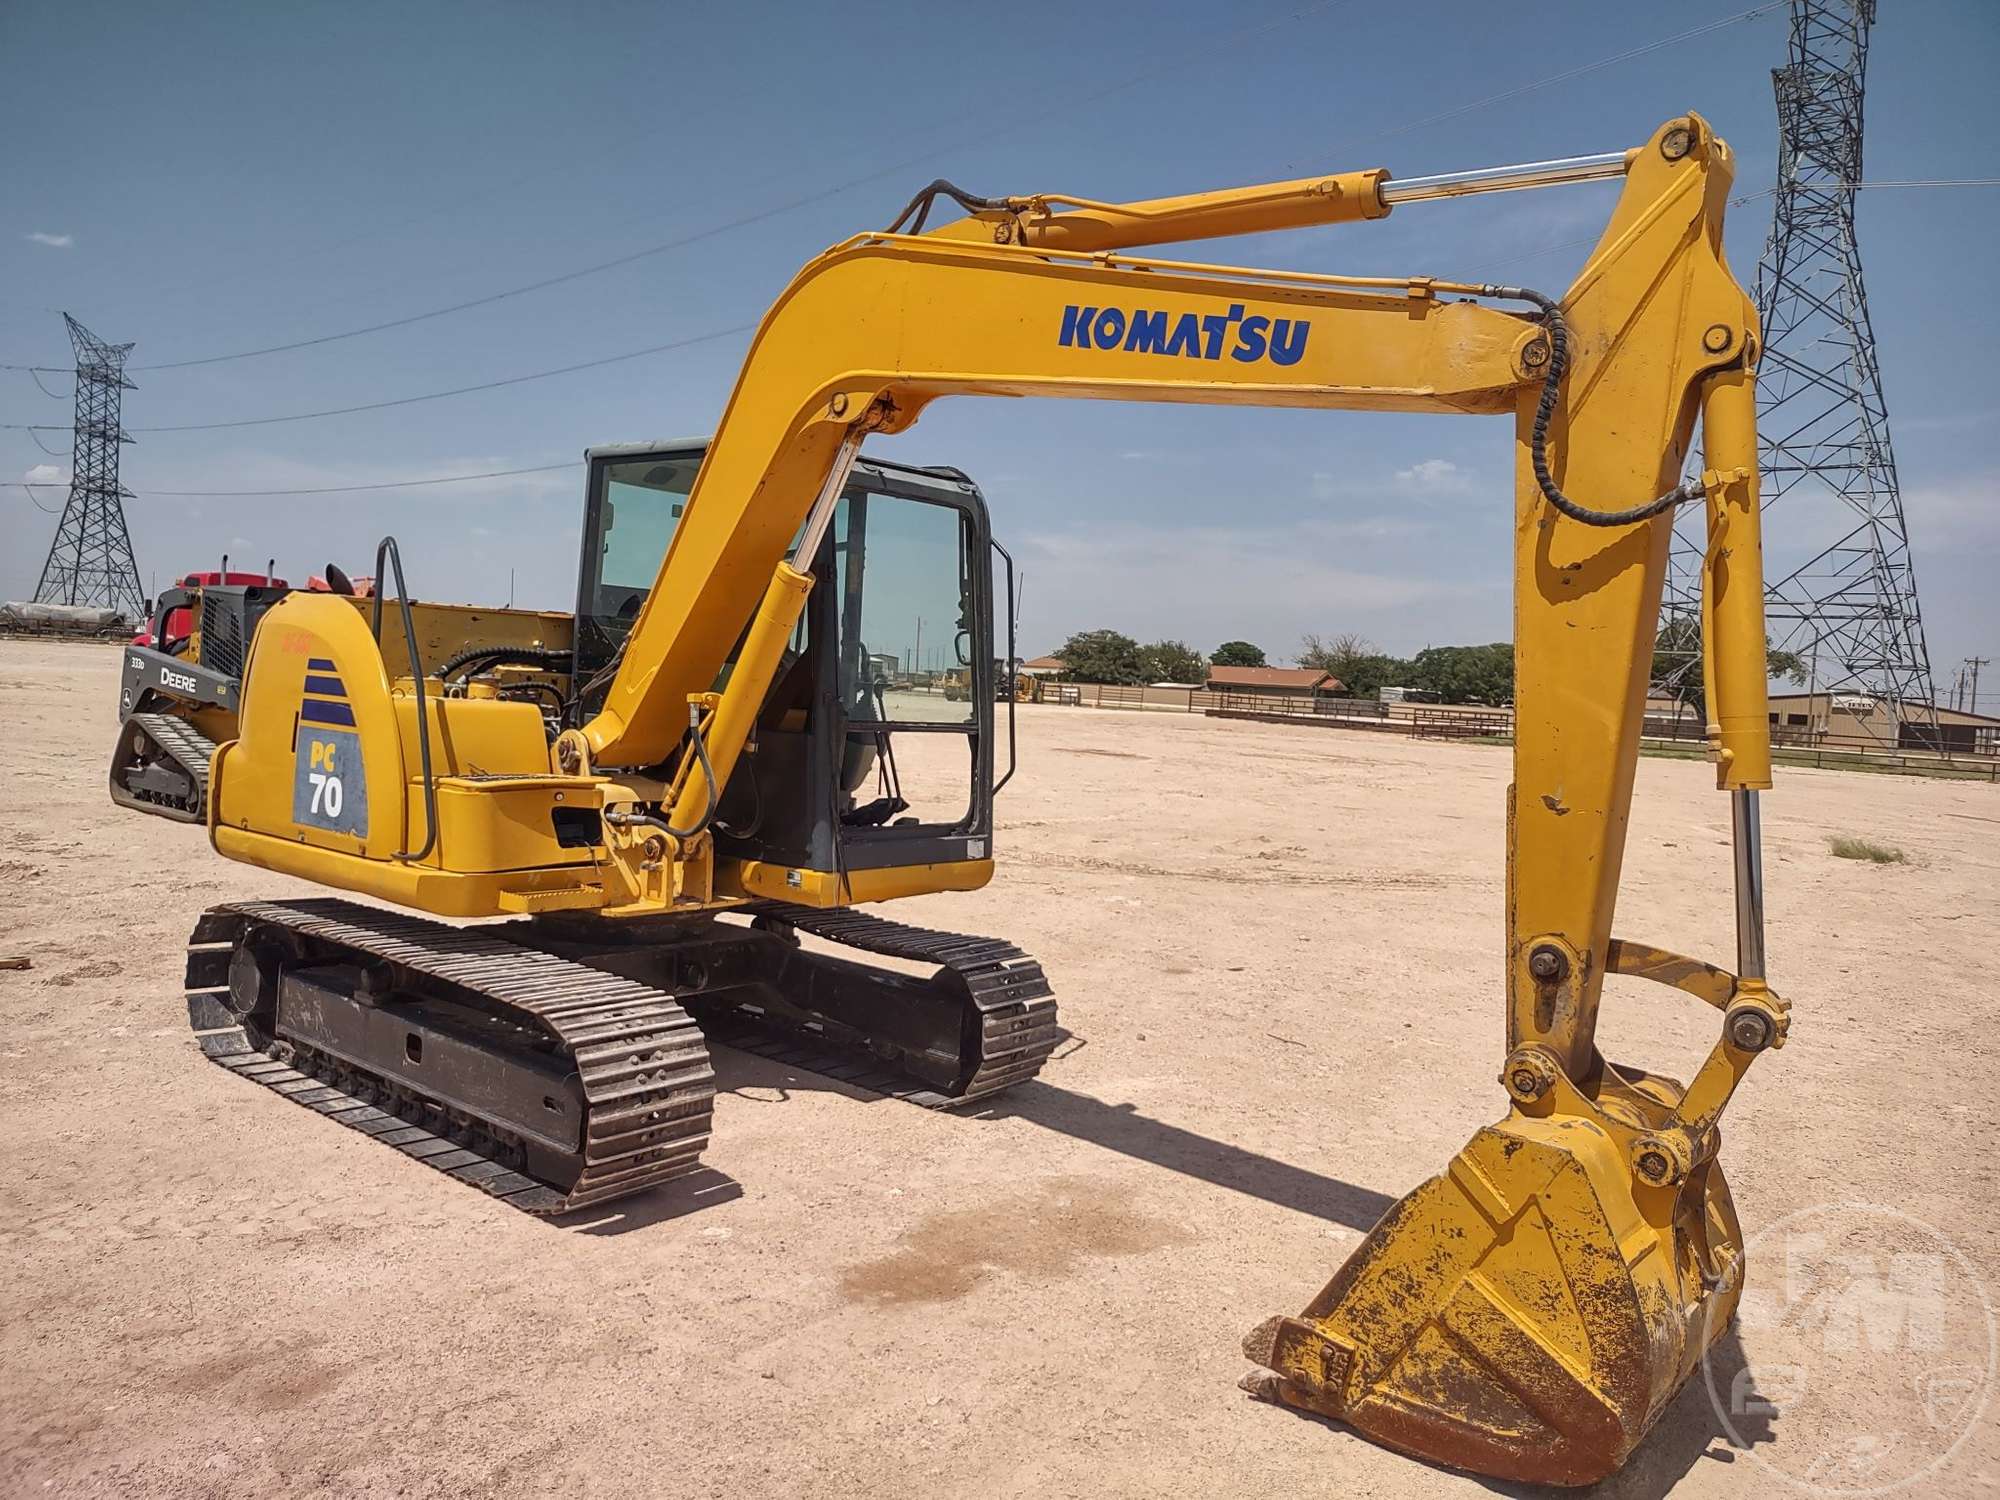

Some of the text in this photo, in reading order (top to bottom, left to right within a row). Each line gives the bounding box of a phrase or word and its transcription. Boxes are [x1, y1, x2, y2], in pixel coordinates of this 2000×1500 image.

[1058, 304, 1311, 366] KOMATSU
[160, 667, 196, 693] DEERE
[310, 740, 337, 772] PC
[309, 773, 342, 818] 70
